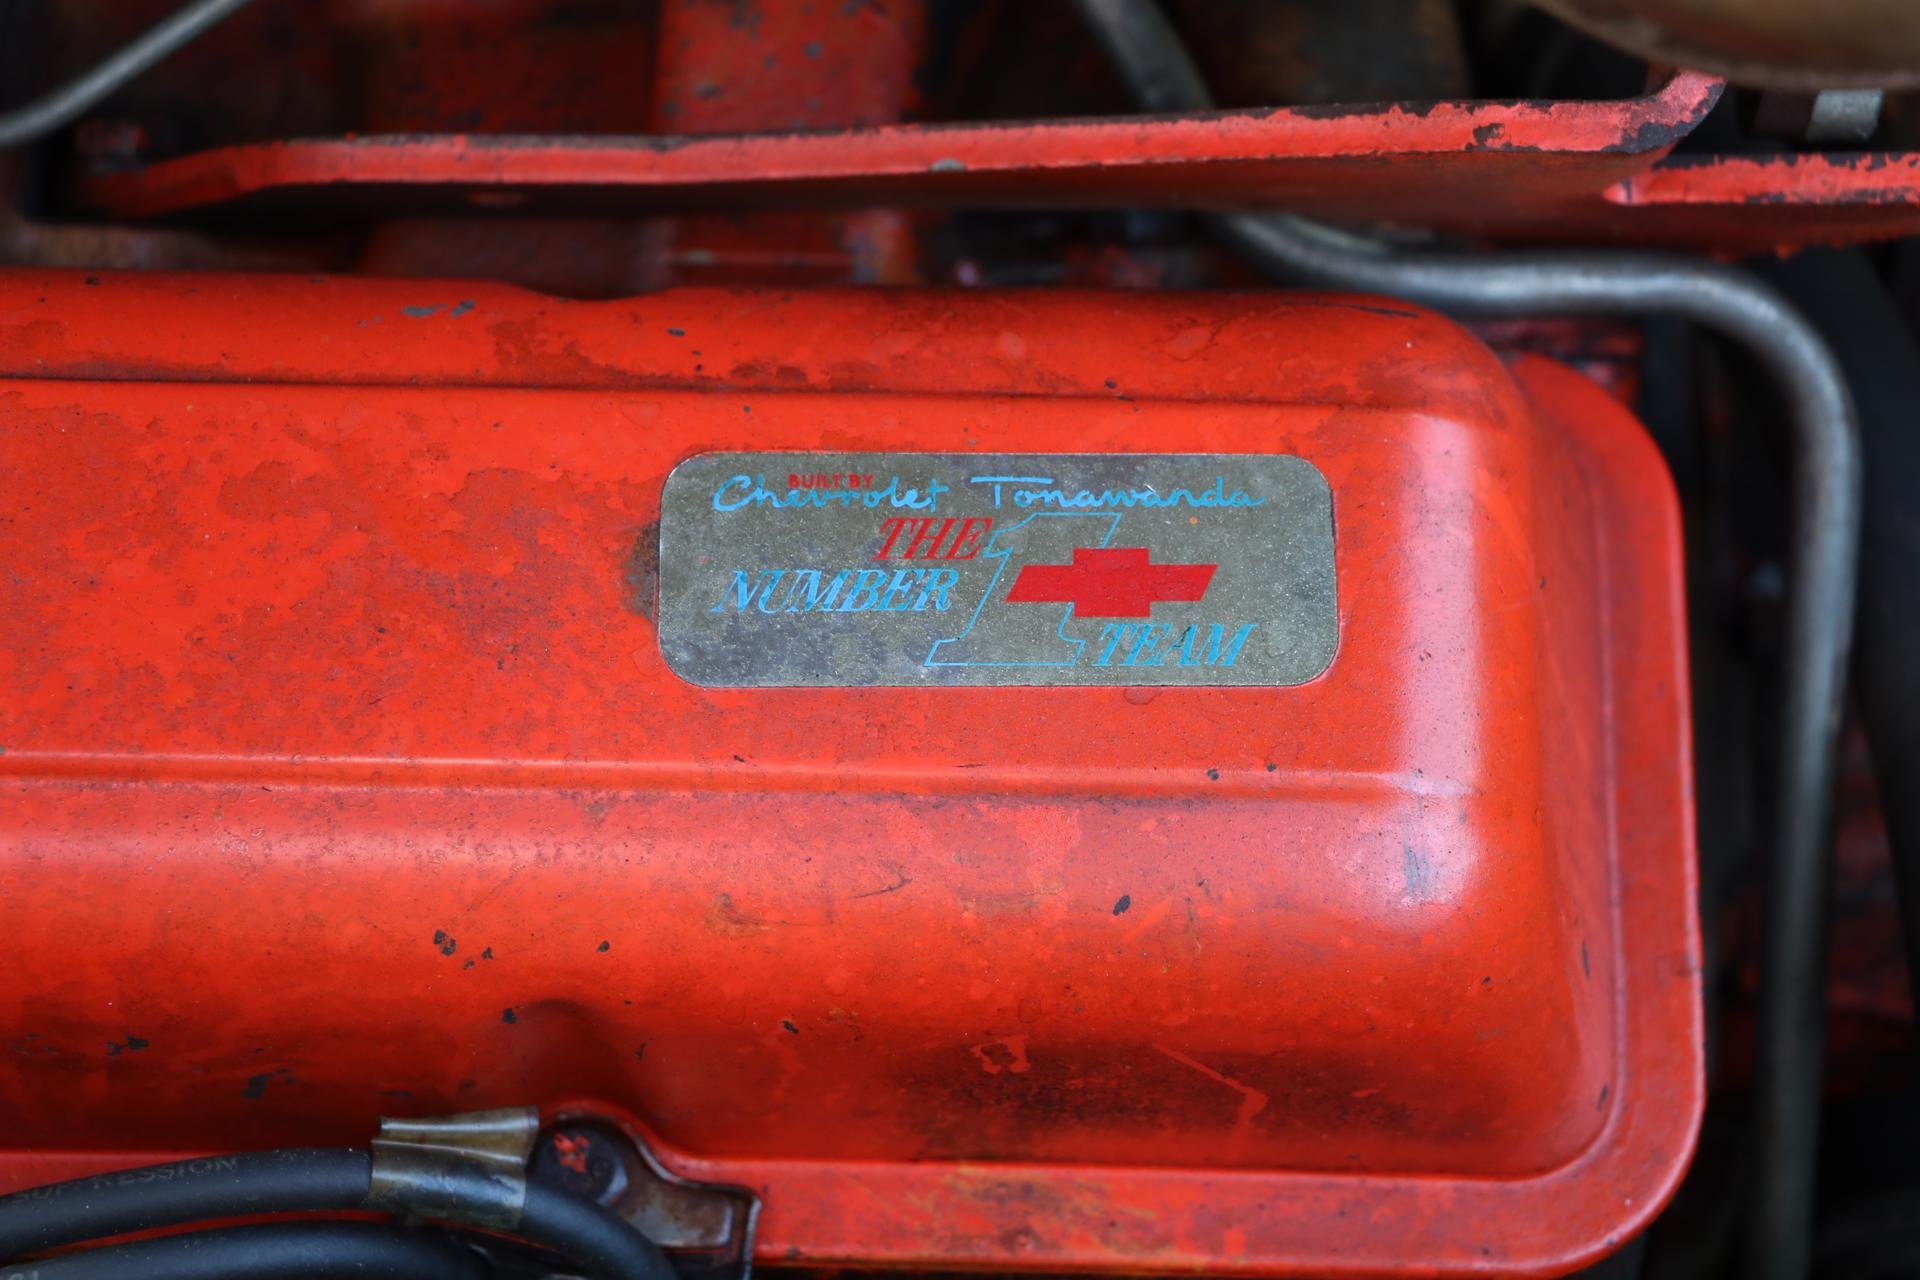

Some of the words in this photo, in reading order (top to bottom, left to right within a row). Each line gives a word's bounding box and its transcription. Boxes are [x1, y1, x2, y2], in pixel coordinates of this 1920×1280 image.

[712, 473, 949, 512] Chevrolet
[970, 475, 1265, 509] Tonawanda
[787, 473, 843, 489] BUILT
[848, 474, 875, 489] BY
[870, 517, 993, 561] THE
[710, 567, 960, 614] NUMBER
[1091, 622, 1258, 667] TEAM
